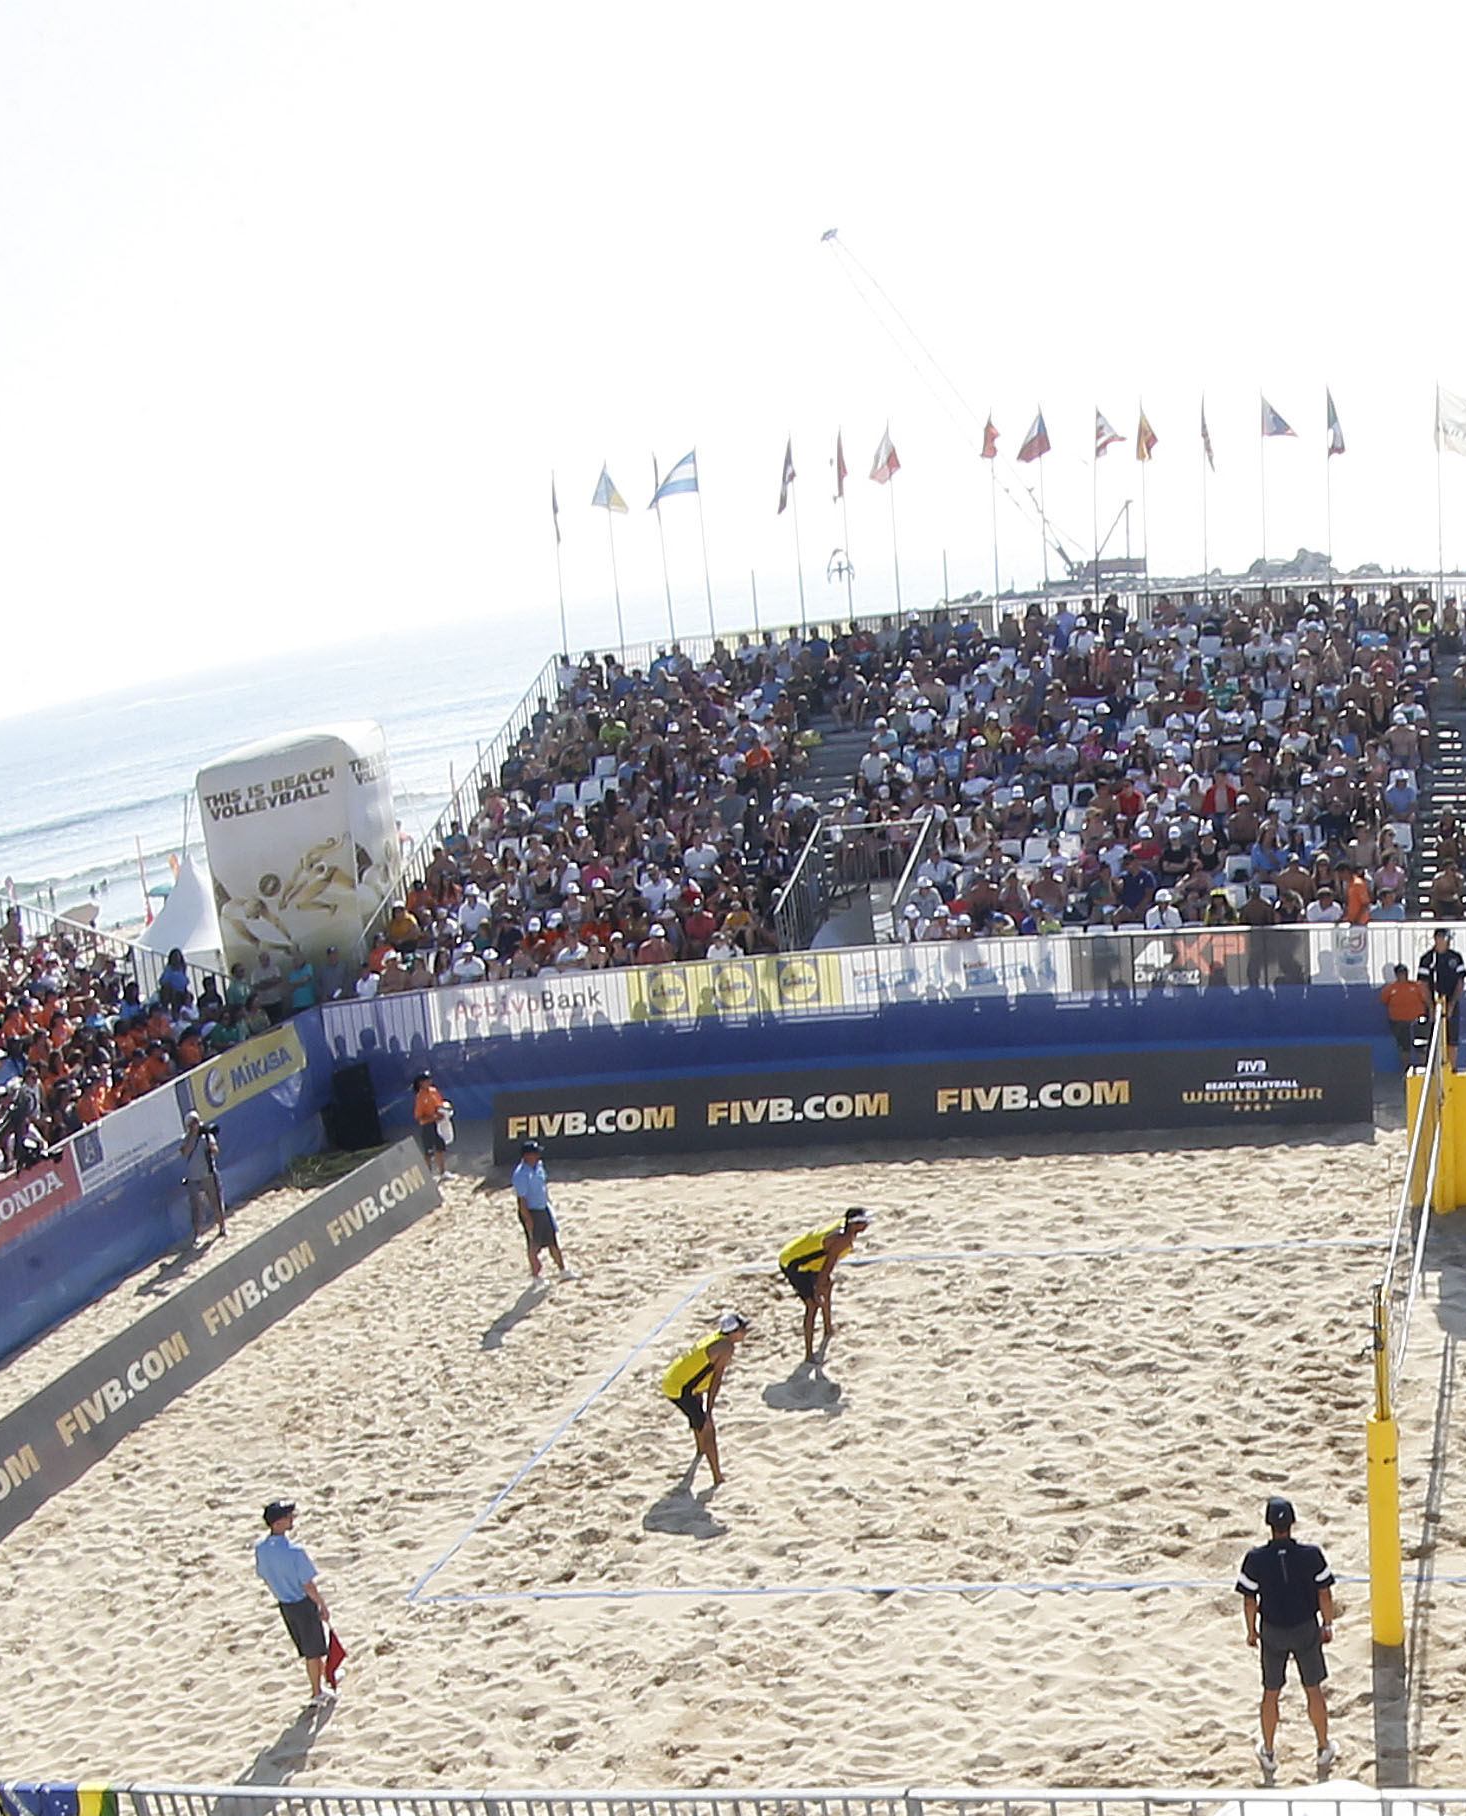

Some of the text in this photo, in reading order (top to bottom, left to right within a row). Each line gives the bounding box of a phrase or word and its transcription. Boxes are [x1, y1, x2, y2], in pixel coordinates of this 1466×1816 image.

[204, 788, 242, 809] THIS
[248, 783, 266, 798] IS
[271, 765, 334, 793] BEACH
[210, 783, 330, 822] VOLLEYBALL
[454, 984, 602, 1022] ActivoBank
[707, 1092, 891, 1126] FIVB.COM
[937, 1079, 1131, 1113] FIVB.COM
[1182, 1087, 1323, 1103] WORLD TOUR
[507, 1105, 676, 1140] FIVB.COM
[326, 1163, 429, 1248] FIVB.COM
[200, 1239, 318, 1337] FIVB.COM
[54, 1330, 192, 1450] FIVB.COM
